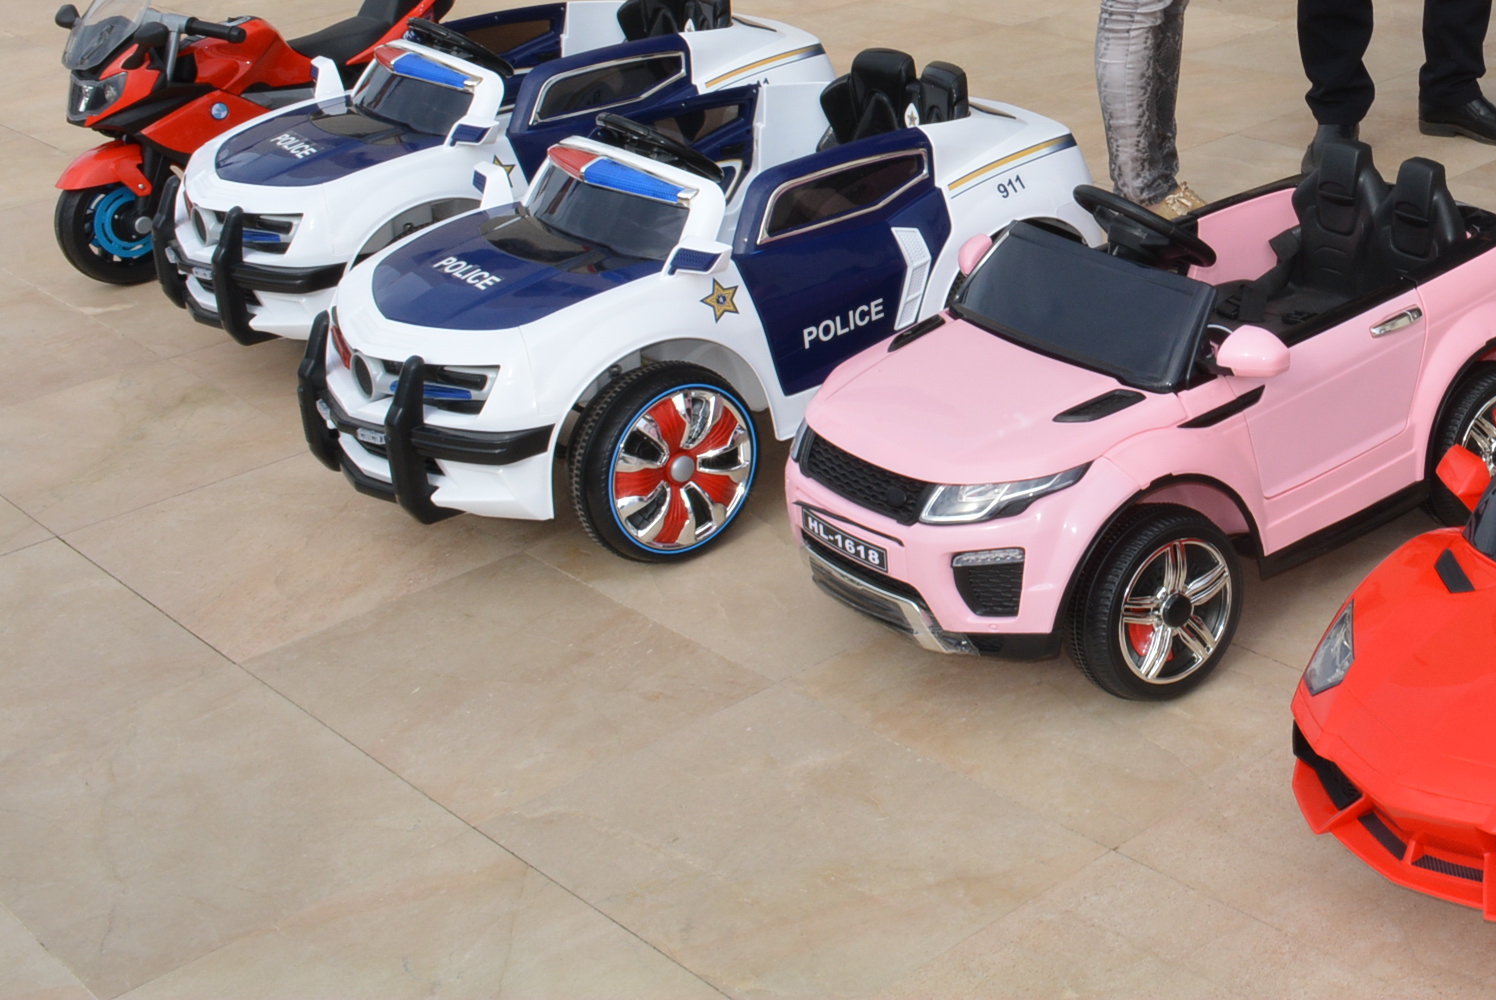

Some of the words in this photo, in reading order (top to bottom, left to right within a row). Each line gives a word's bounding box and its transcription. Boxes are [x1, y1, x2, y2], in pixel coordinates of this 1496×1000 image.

[270, 133, 318, 159] POLICE
[997, 174, 1026, 199] 911
[432, 256, 502, 290] POLICE
[803, 298, 885, 349] POLICE
[808, 516, 880, 565] HL-1618
